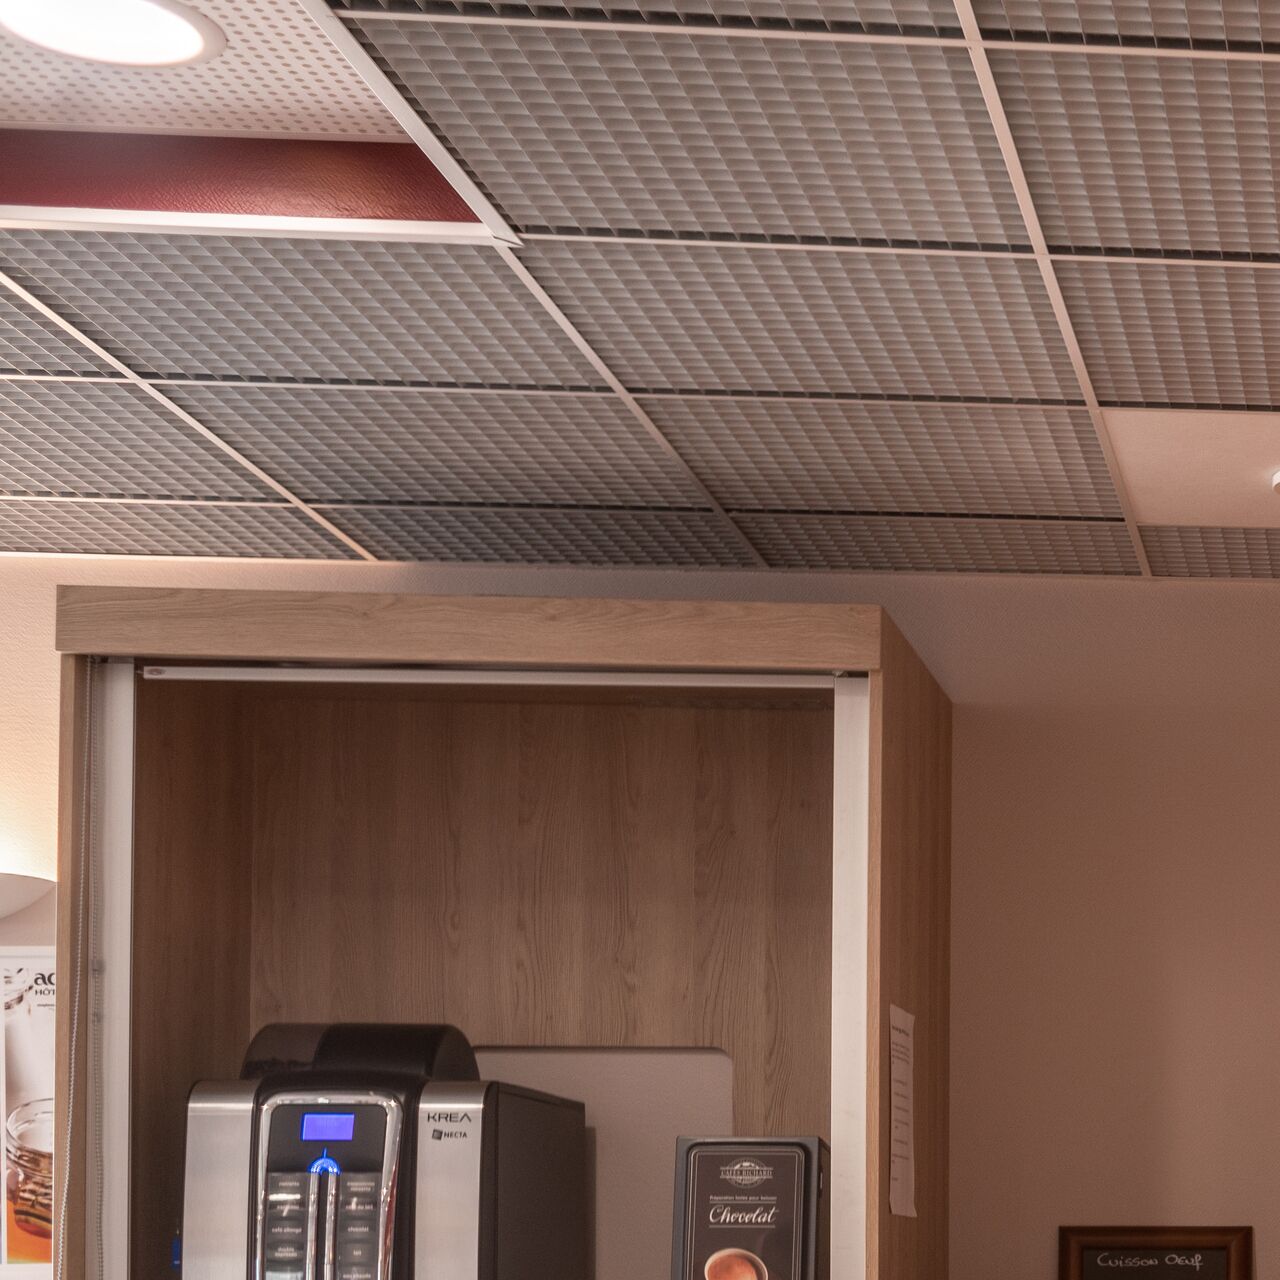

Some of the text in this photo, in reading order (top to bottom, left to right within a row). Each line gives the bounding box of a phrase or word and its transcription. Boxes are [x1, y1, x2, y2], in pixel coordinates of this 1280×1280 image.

[427, 1112, 472, 1122] KREA
[443, 1131, 467, 1139] NECTA
[742, 1168, 773, 1177] RICHARD
[709, 1205, 779, 1223] Chocolat
[1096, 1253, 1159, 1268] Cuisson
